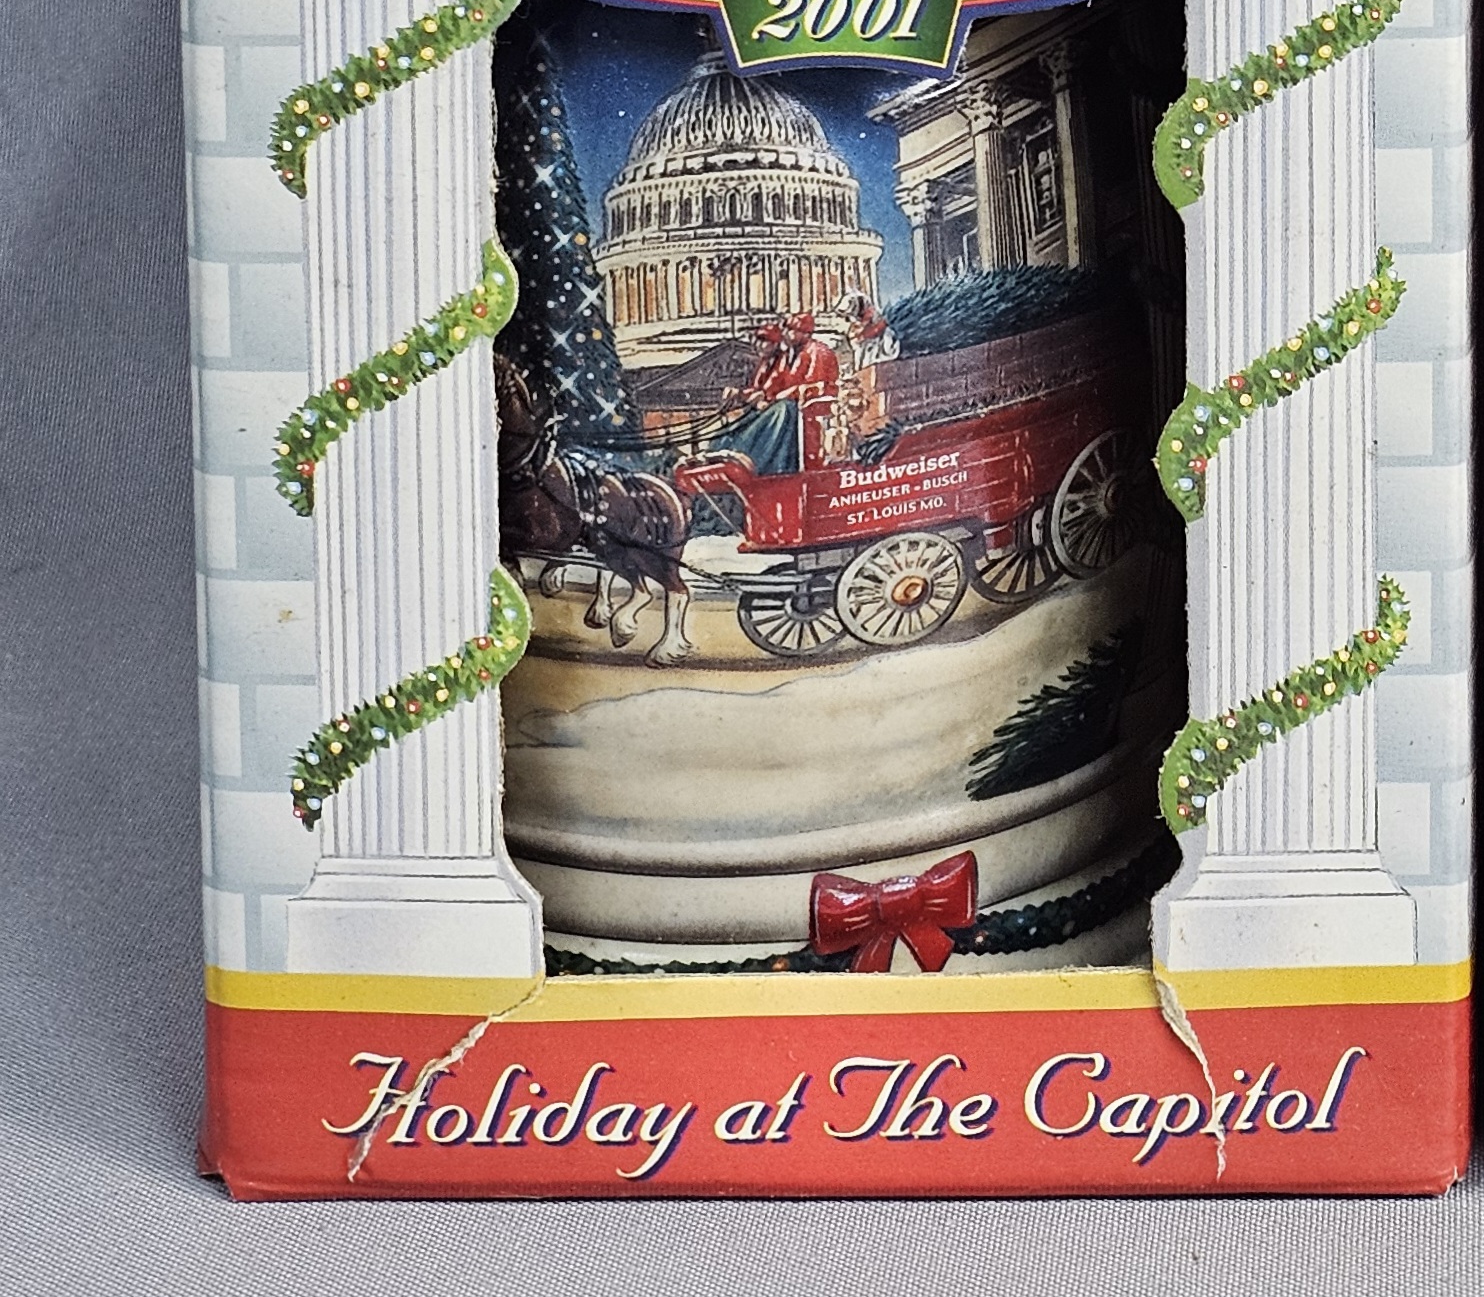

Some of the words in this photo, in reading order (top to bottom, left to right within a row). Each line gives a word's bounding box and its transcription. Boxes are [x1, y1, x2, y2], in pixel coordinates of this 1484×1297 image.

[839, 451, 961, 490] Budweiser
[872, 502, 917, 522] LOUIS
[919, 496, 948, 512] MO.
[322, 1050, 693, 1180] Holiday
[713, 1070, 810, 1145] at
[822, 1051, 999, 1144] The
[1022, 1045, 1370, 1166] Capitol
